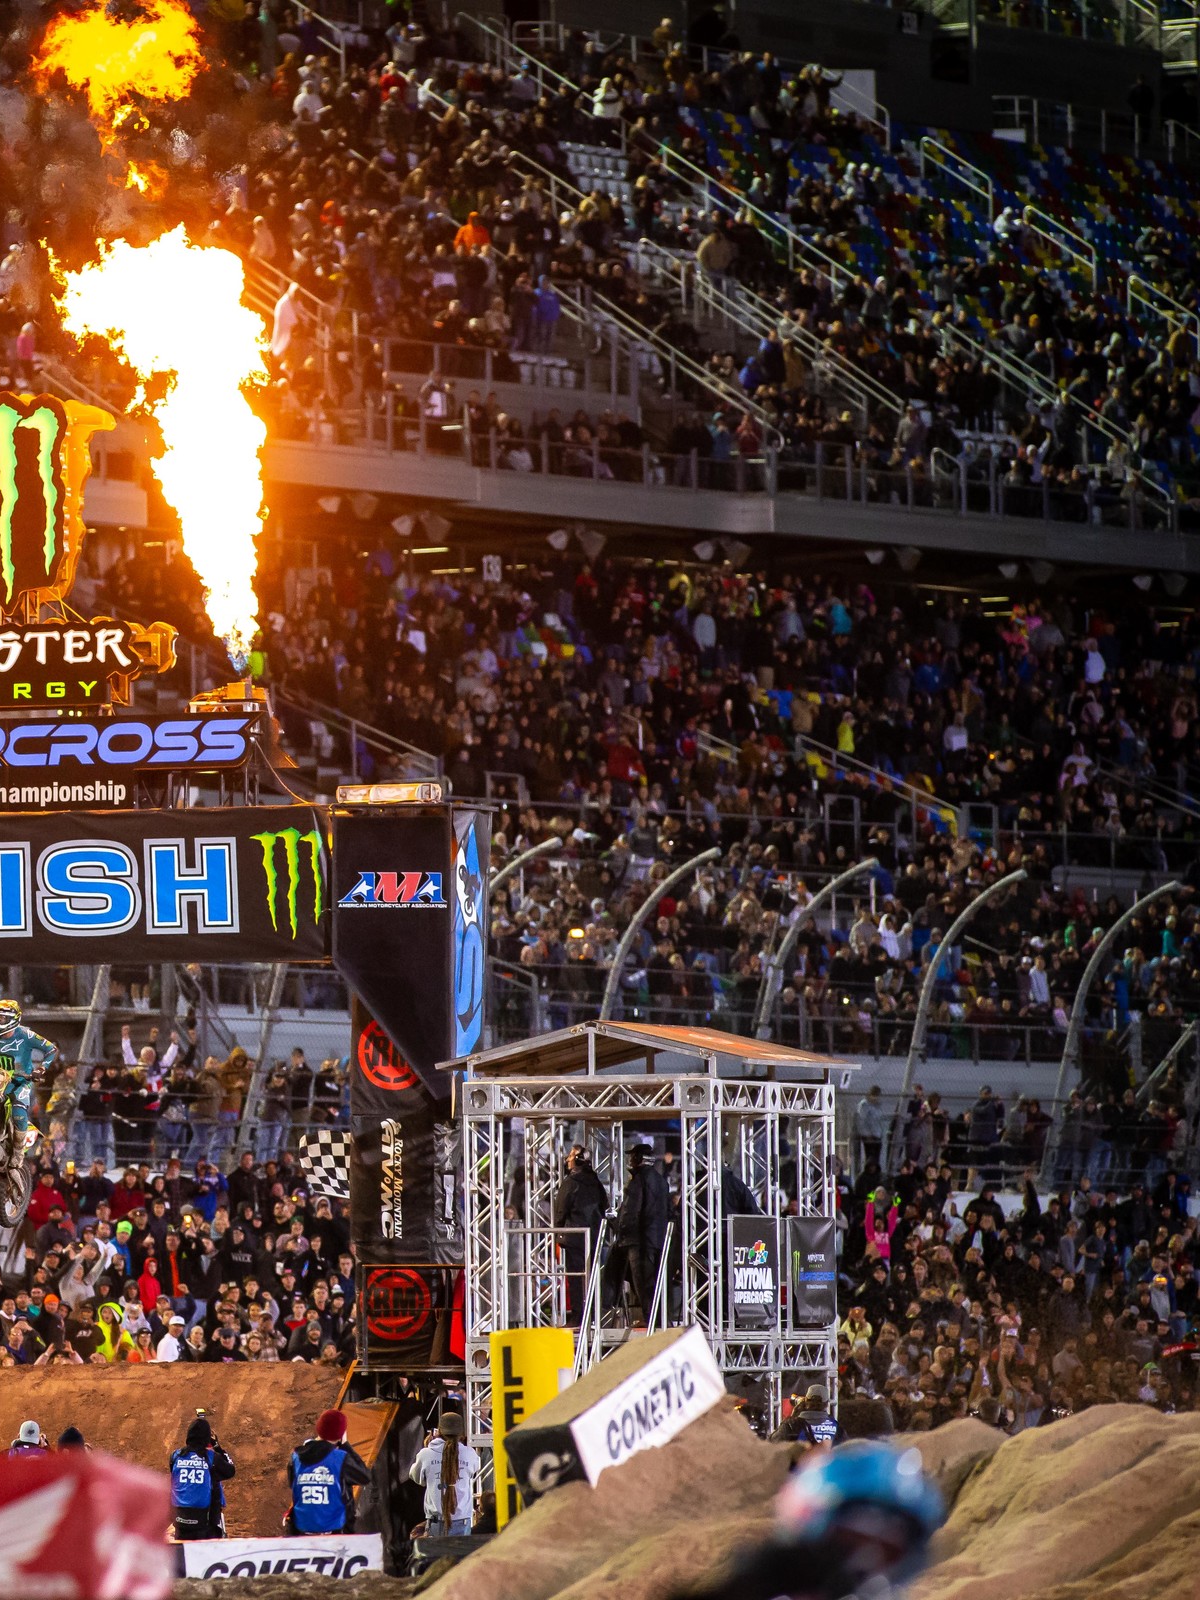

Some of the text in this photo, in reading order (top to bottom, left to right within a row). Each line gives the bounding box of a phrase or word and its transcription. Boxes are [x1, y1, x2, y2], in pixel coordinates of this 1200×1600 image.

[337, 871, 448, 903] AMA
[394, 1137, 404, 1240] ROCKY MOUNTAIN
[606, 1361, 696, 1460] COMETIC
[179, 1468, 205, 1484] 243
[301, 1485, 330, 1505] 251
